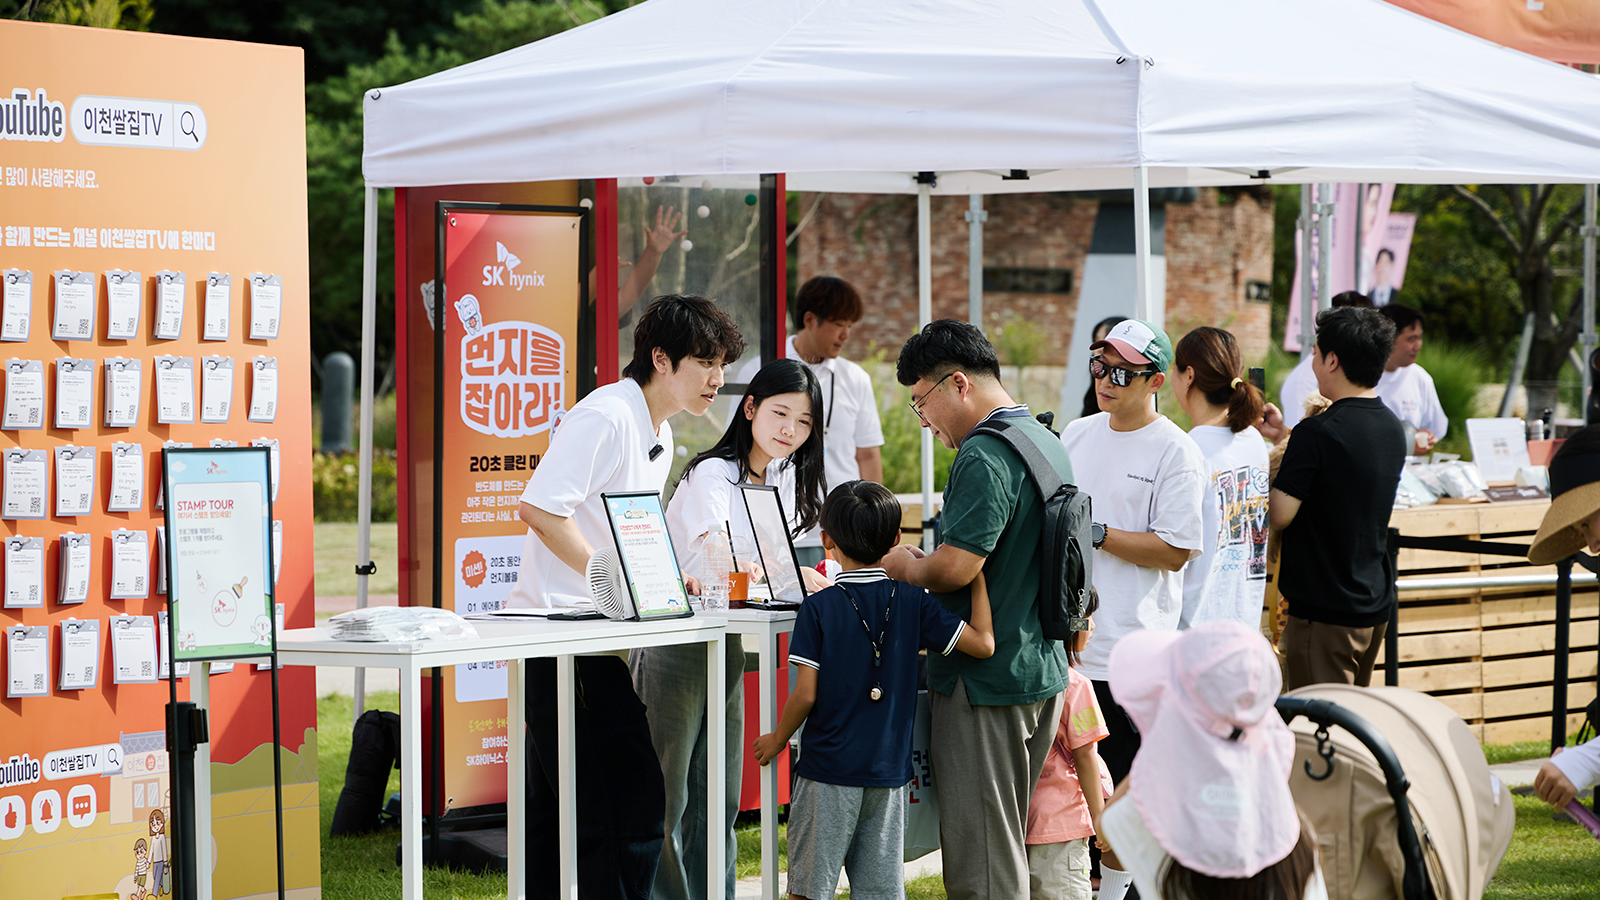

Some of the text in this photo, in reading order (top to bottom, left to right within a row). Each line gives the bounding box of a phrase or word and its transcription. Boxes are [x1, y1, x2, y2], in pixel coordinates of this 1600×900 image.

[84, 107, 163, 136] 이천쌀집TV
[6, 167, 28, 186] 많이
[31, 168, 99, 188] 사랑해주세요.
[5, 226, 215, 251] 함께 만드는 채널 이천쌀집TV에 한마디
[482, 265, 545, 291] SK hynix
[465, 328, 561, 377] 먼지를
[465, 381, 561, 431] 잡아라!
[470, 454, 541, 472] 20초 클린 미
[476, 480, 524, 493] 반도체를 만드는
[177, 499, 234, 511] STAMP TOUR
[467, 497, 480, 508] 아주
[482, 496, 495, 507] 작은
[461, 511, 495, 523] 관리된다는
[465, 561, 484, 578] 미션!
[490, 556, 521, 568] 20초 동안
[490, 572, 518, 584] 먼지볼을
[467, 602, 477, 612] 01
[50, 753, 98, 774] 이천쌀집TV
[466, 752, 504, 767] SK하이닉스
